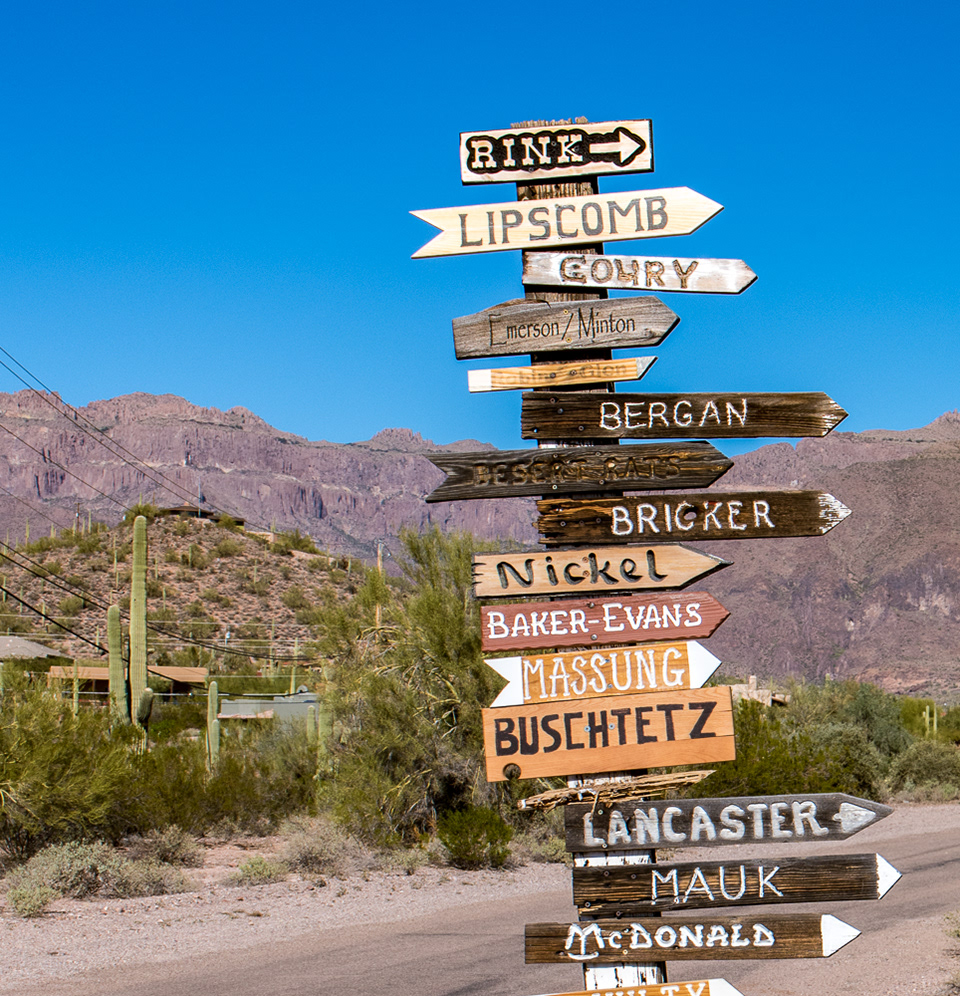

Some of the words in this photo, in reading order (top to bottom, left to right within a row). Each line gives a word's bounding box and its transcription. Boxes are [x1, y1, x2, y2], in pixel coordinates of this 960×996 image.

[470, 133, 584, 169] RINK
[458, 195, 669, 248] LIPSCOMB
[599, 398, 748, 431] BERGAN
[611, 499, 776, 537] BRICKER
[496, 549, 669, 590] Nickel
[486, 602, 703, 640] BAKER-EVANS
[522, 646, 687, 701] MASSUNG
[494, 701, 718, 757] BUSCHTETZ
[582, 800, 830, 847] LANCASTER
[651, 865, 785, 906] MAUK
[564, 922, 776, 961] McDONALD
